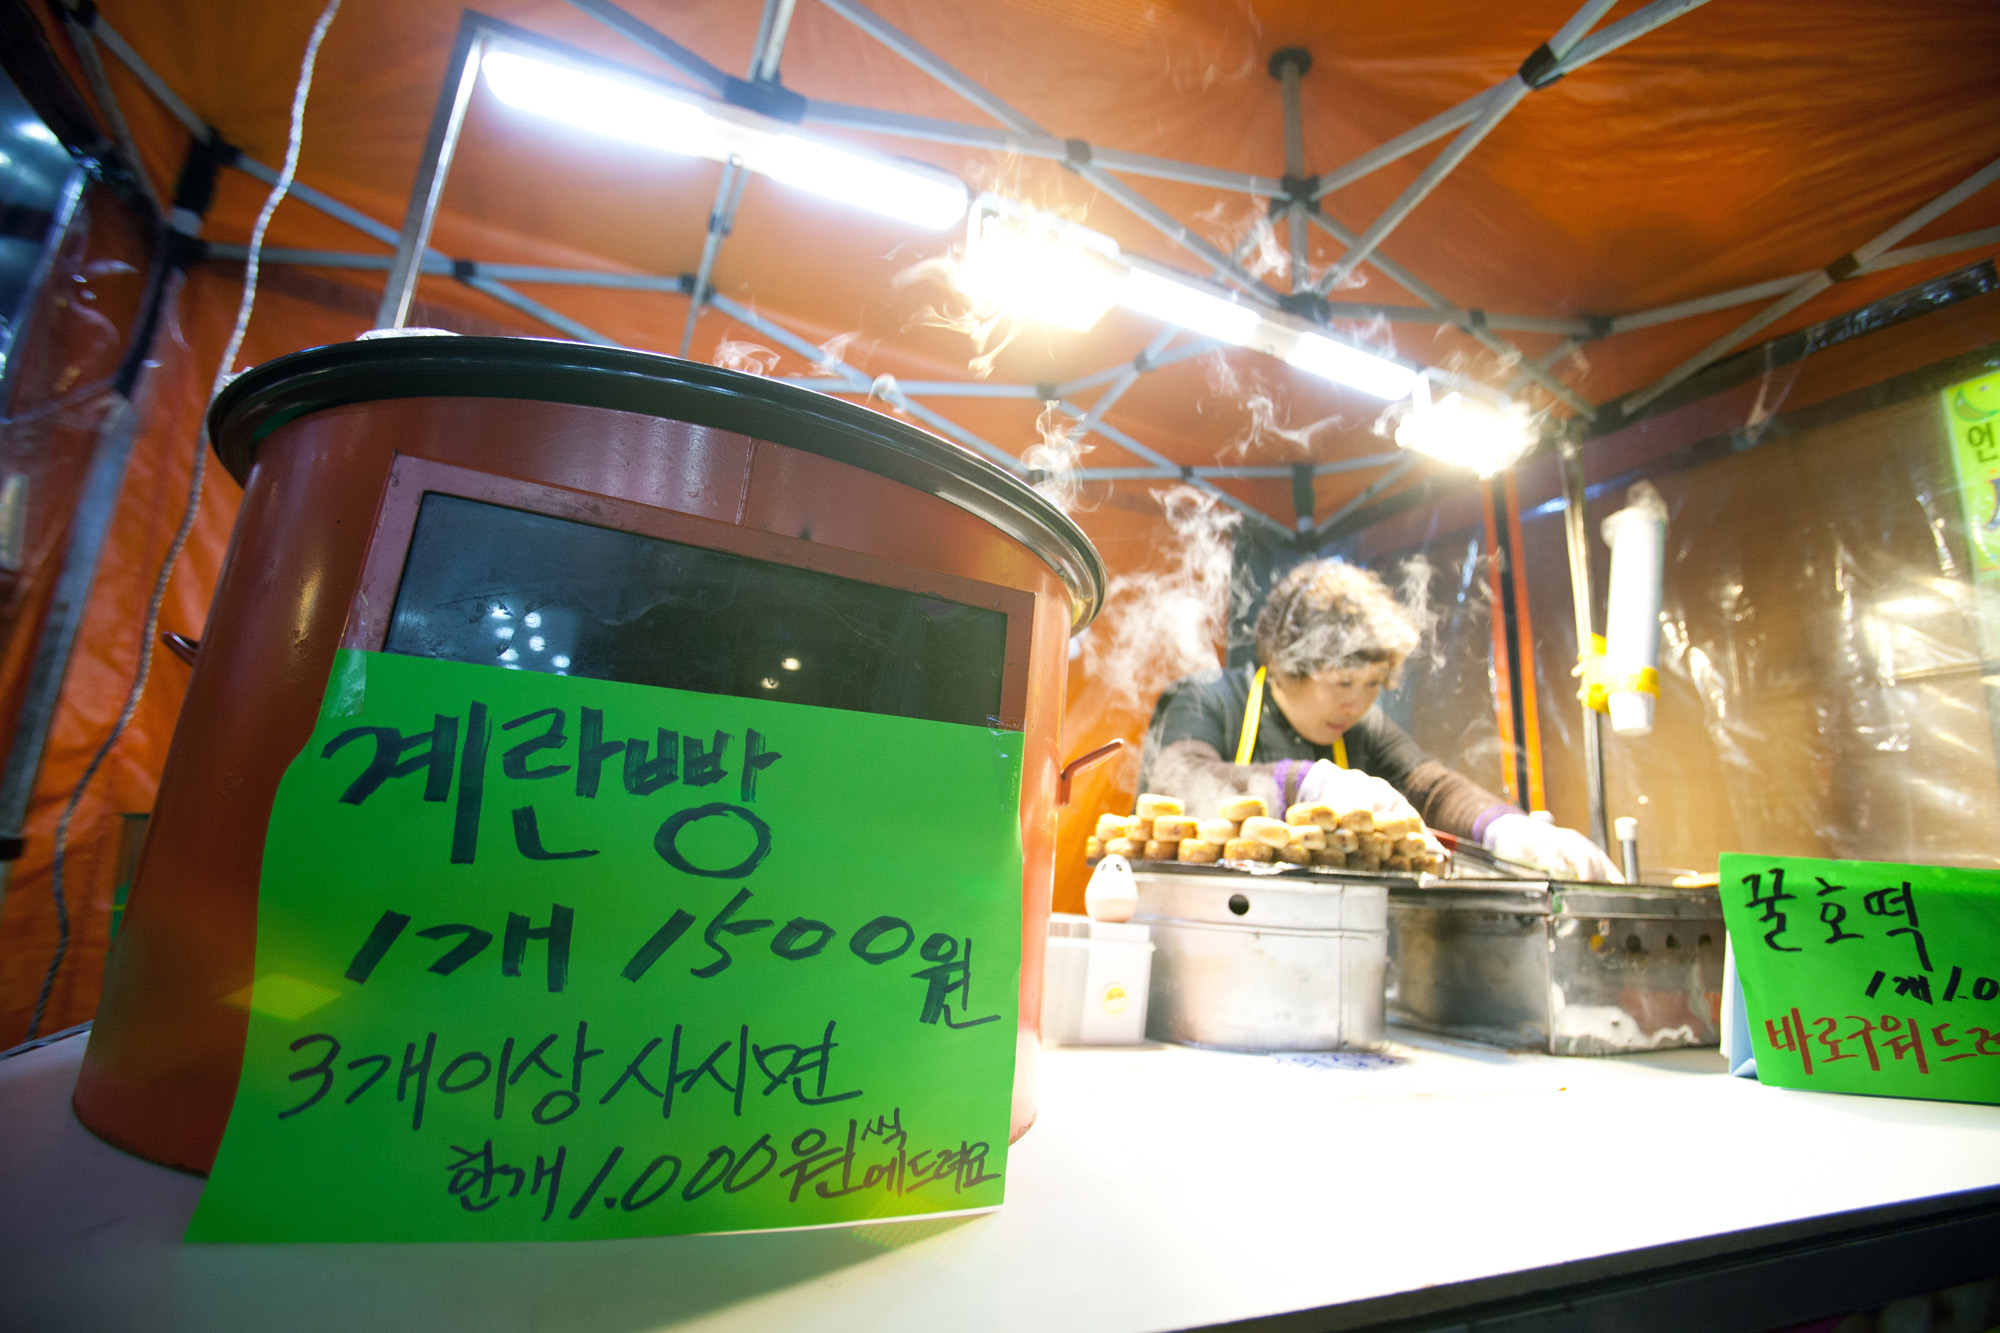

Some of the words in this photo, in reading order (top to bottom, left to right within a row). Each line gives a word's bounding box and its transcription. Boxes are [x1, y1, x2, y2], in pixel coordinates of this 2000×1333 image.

[319, 699, 782, 879] 계란빵
[344, 902, 575, 993] 1개
[620, 887, 1001, 1030] 1500원
